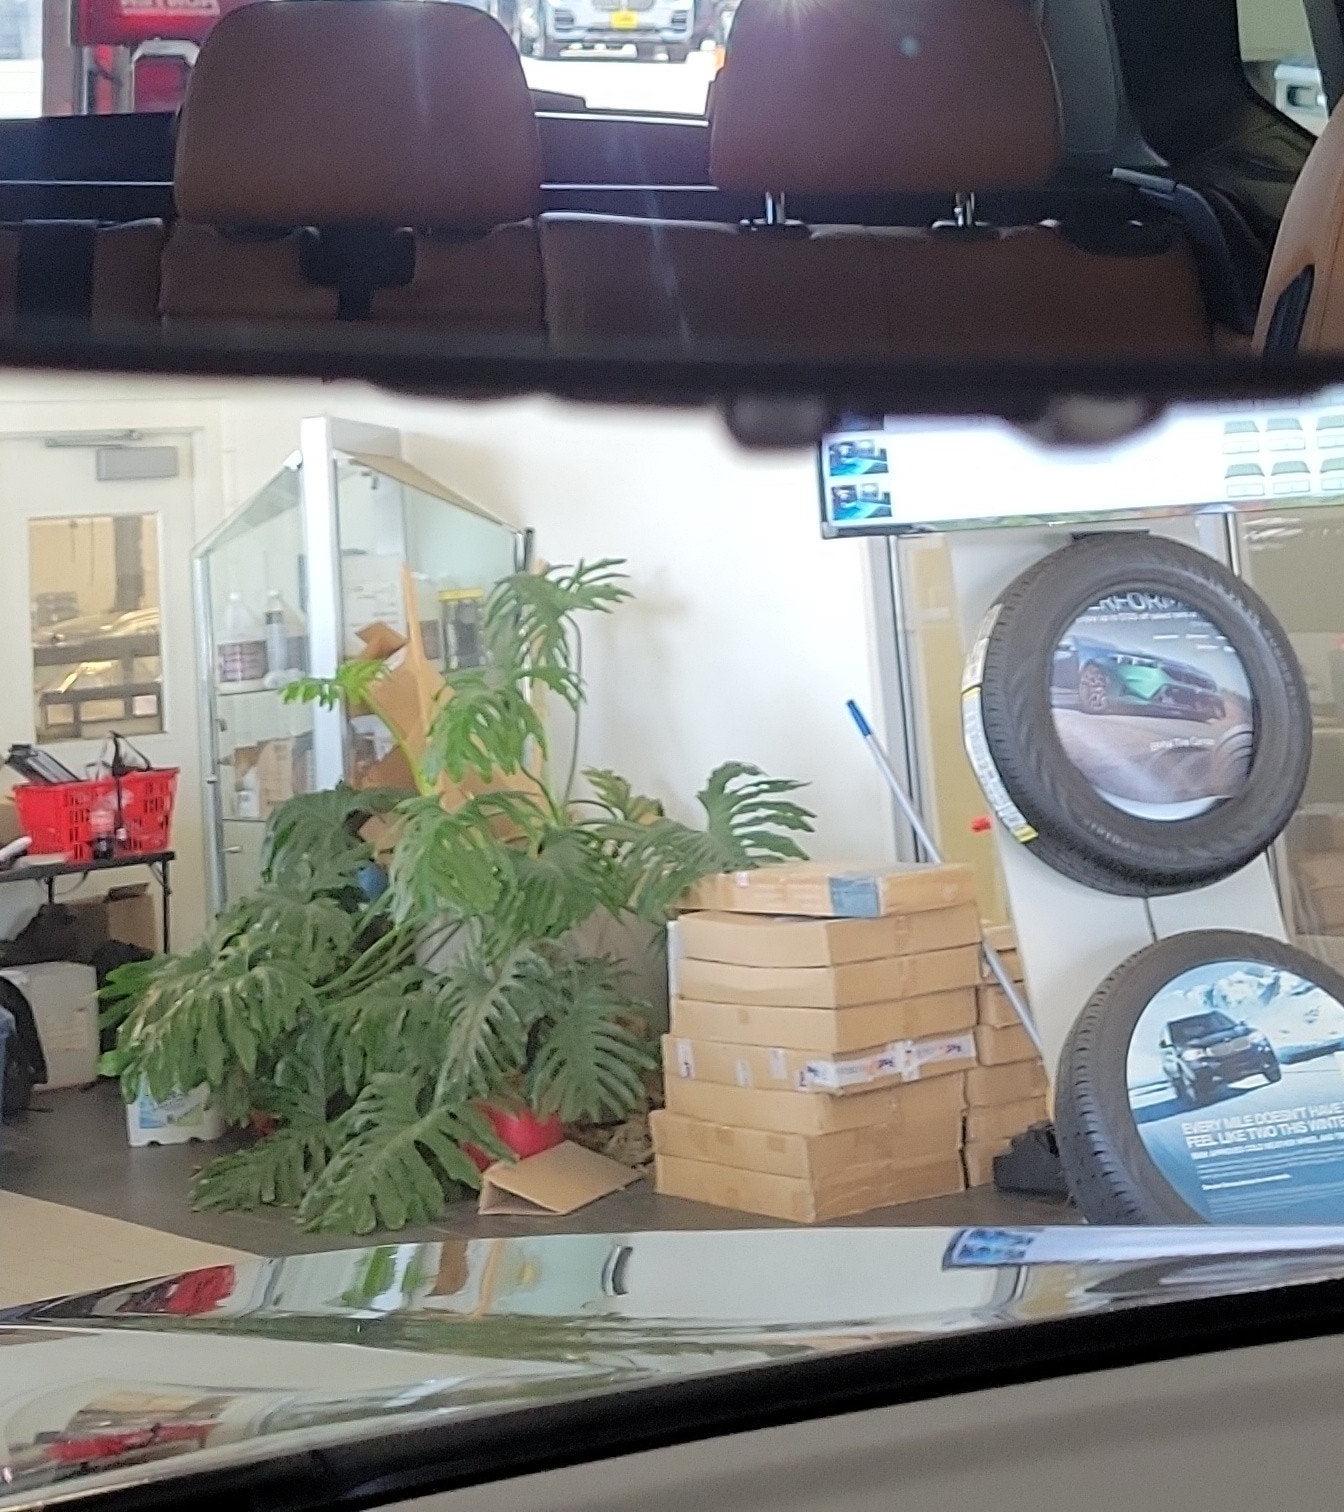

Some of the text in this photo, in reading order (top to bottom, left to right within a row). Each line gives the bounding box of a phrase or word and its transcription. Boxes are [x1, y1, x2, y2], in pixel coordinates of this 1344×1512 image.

[1181, 1118, 1222, 1136] EVERY
[1223, 1113, 1255, 1131] MILE
[1255, 1106, 1306, 1126] DOESN'T
[1309, 1101, 1344, 1118] HAVE
[1185, 1133, 1219, 1149] FEEL
[1218, 1129, 1247, 1145] LIKE
[1247, 1124, 1278, 1141] TWO
[1277, 1121, 1308, 1137] THIS
